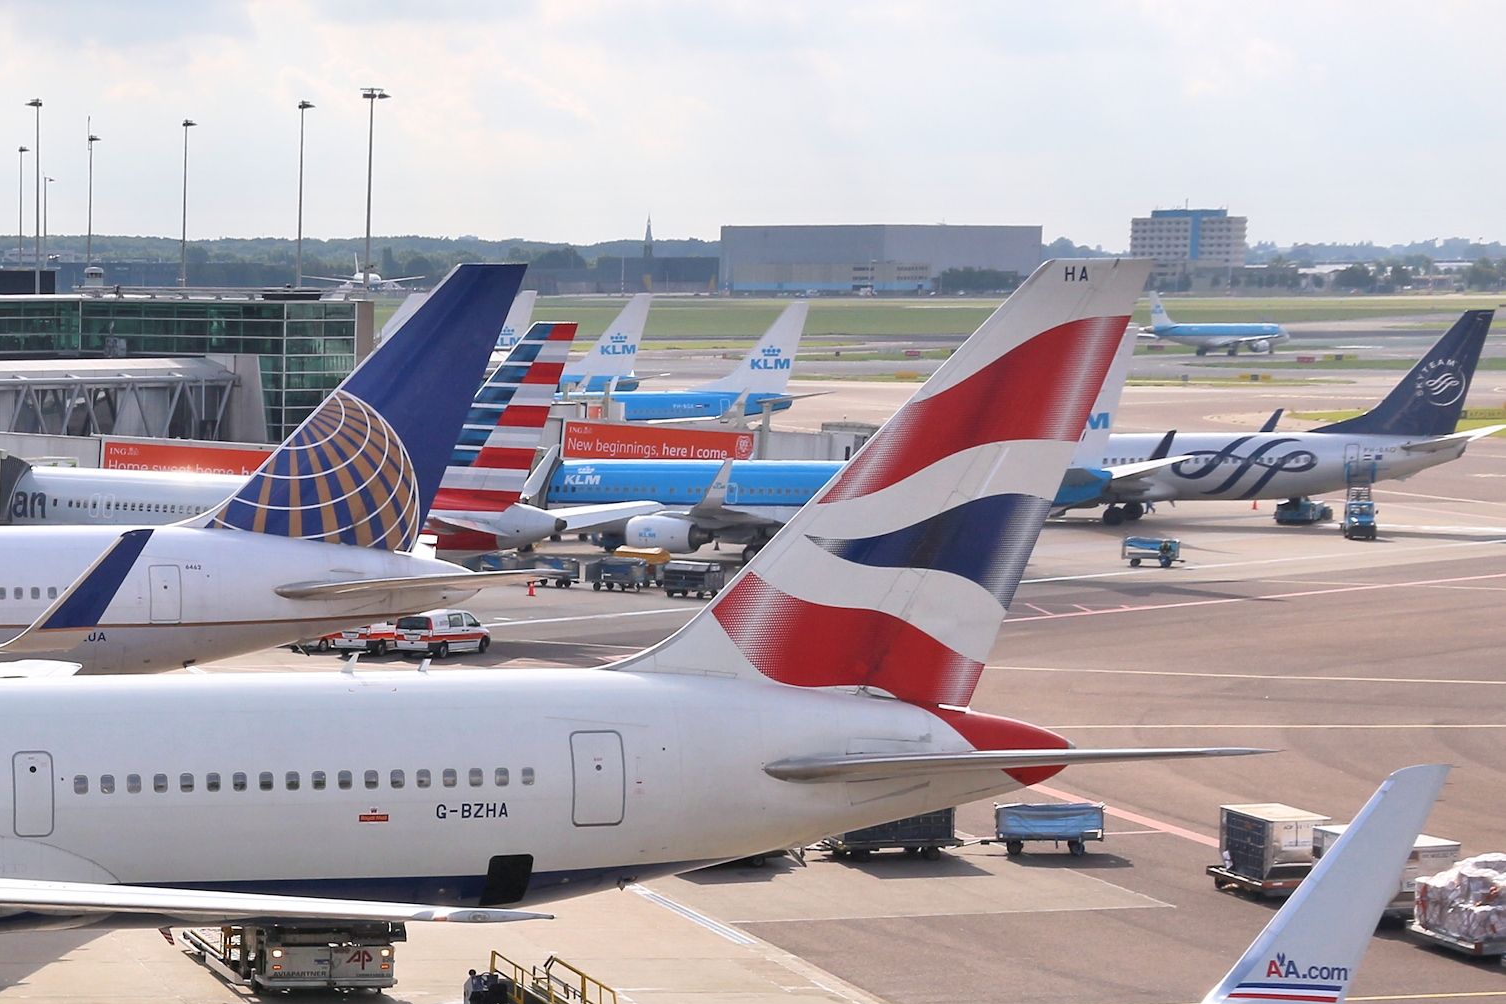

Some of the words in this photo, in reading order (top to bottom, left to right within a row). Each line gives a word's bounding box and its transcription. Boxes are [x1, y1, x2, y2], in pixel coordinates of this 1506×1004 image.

[1065, 266, 1088, 281] HA
[600, 344, 636, 355] KLM
[750, 358, 790, 369] KLM
[1415, 359, 1456, 397] SKYTEAM
[569, 426, 583, 434] ING
[109, 447, 127, 455] ING
[568, 437, 593, 451] New
[595, 439, 659, 457] beginnings,
[662, 445, 687, 457] here
[690, 446, 695, 458] I
[697, 449, 728, 459] come
[564, 474, 601, 485] KLM
[436, 803, 509, 819] G-BZHA
[1266, 960, 1348, 981] AA.com
